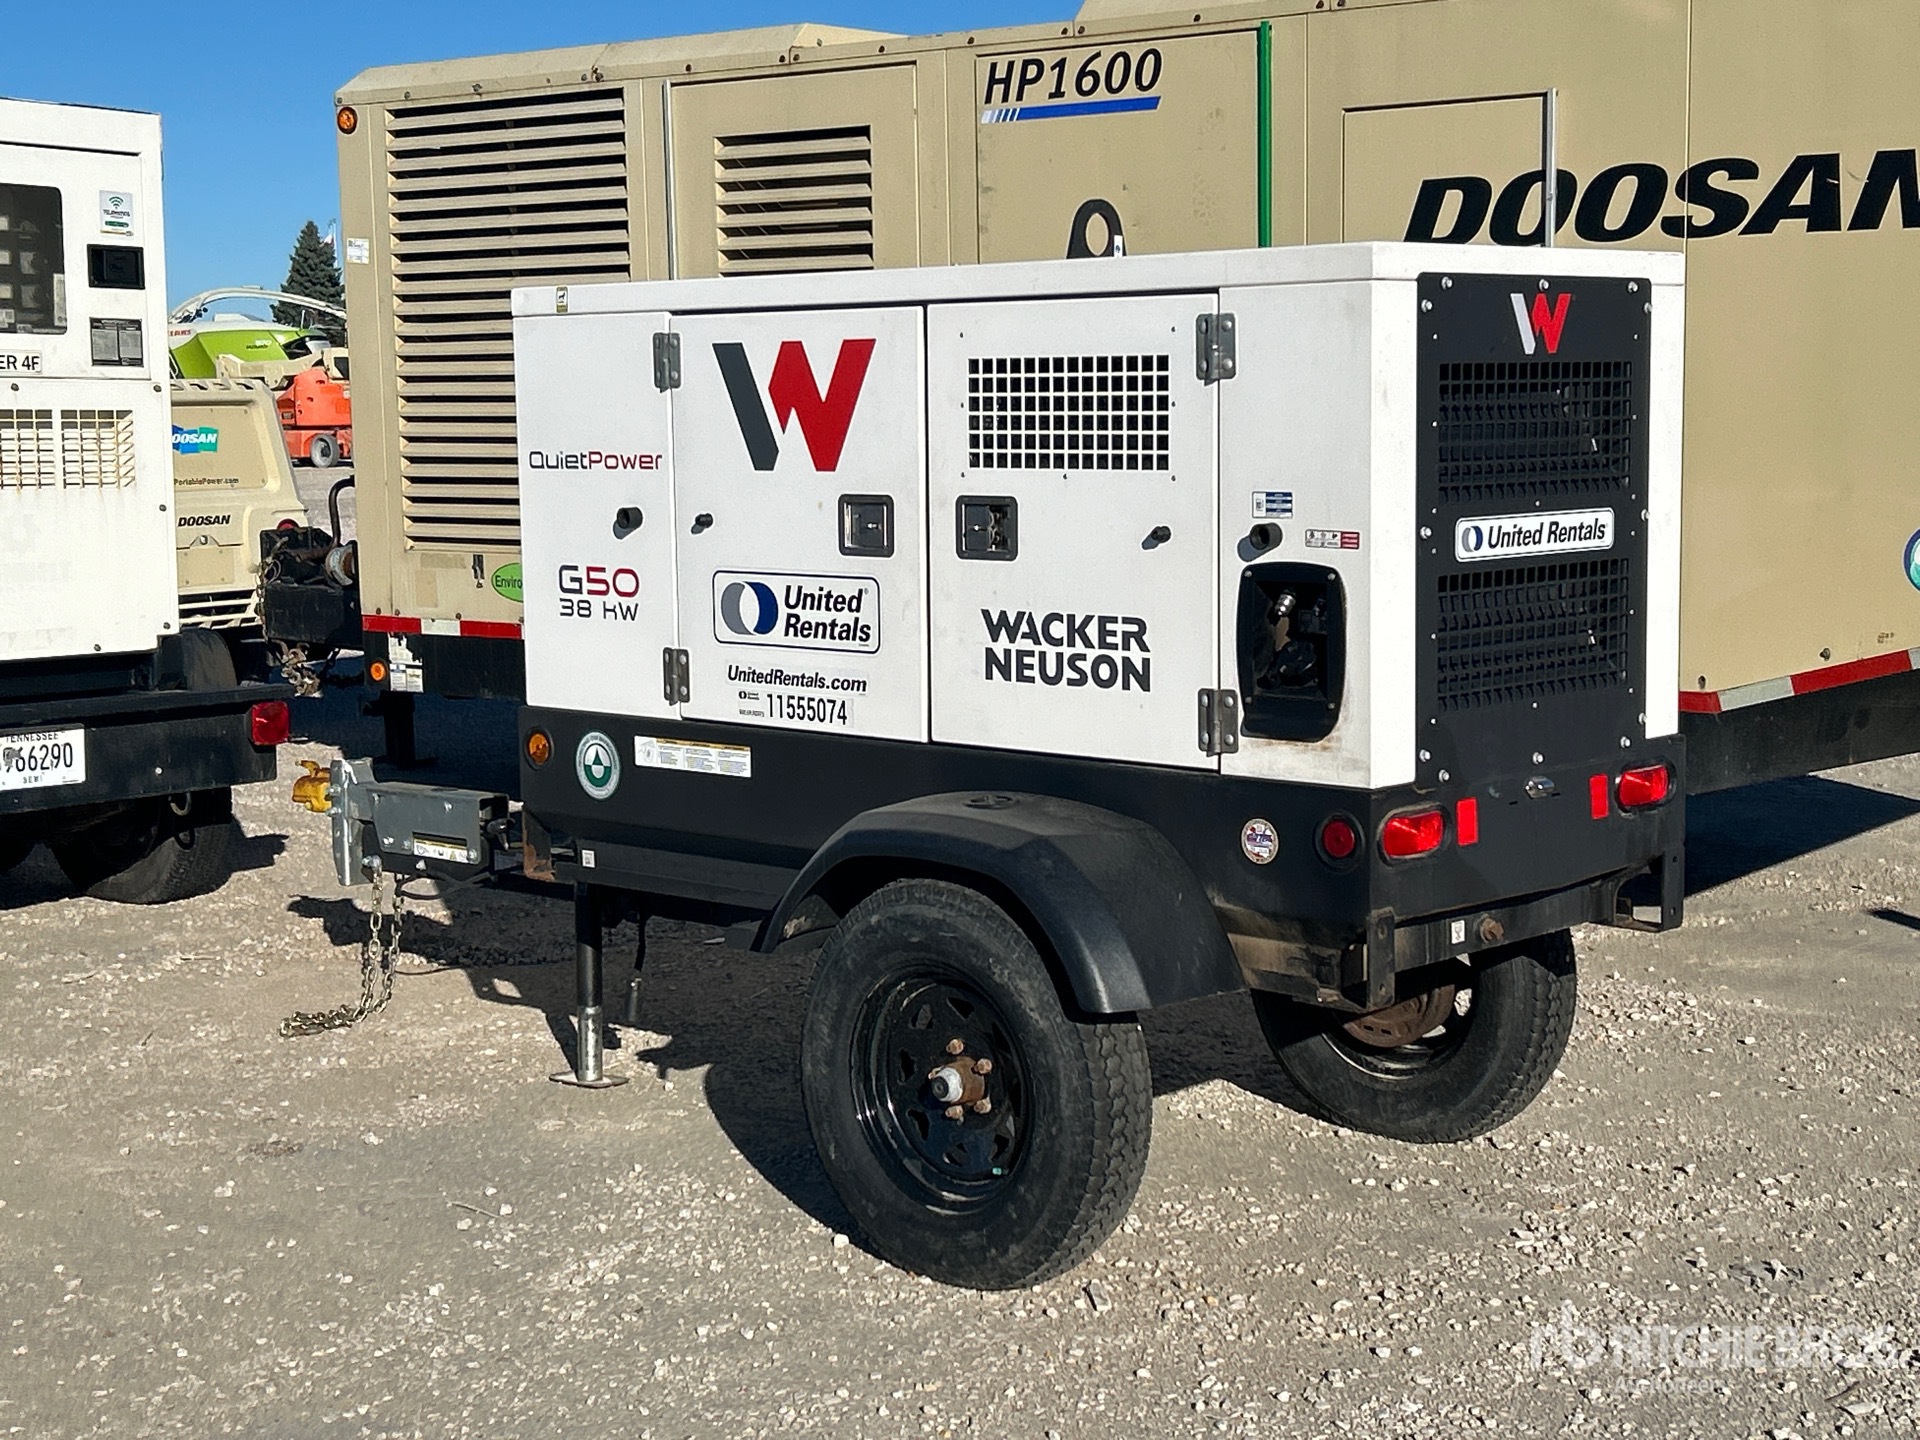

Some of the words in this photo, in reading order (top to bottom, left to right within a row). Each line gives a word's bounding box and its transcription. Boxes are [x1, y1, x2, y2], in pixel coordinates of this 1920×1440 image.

[984, 48, 1162, 105] HP1600
[0, 354, 18, 370] ER
[21, 355, 41, 371] 4F
[528, 450, 664, 470] QuietPower
[177, 514, 231, 527] DOOSAN
[1487, 521, 1545, 549] United
[1546, 517, 1607, 544] Rentals
[558, 564, 640, 598] G50
[559, 597, 592, 618] 38
[602, 601, 640, 622] kW
[784, 584, 864, 614] United
[784, 612, 873, 643] Rentals
[980, 608, 1151, 653] WACKER
[727, 664, 868, 693] UnitedRentals.com
[984, 646, 1152, 693] NEUSON
[766, 693, 848, 726] 11555074
